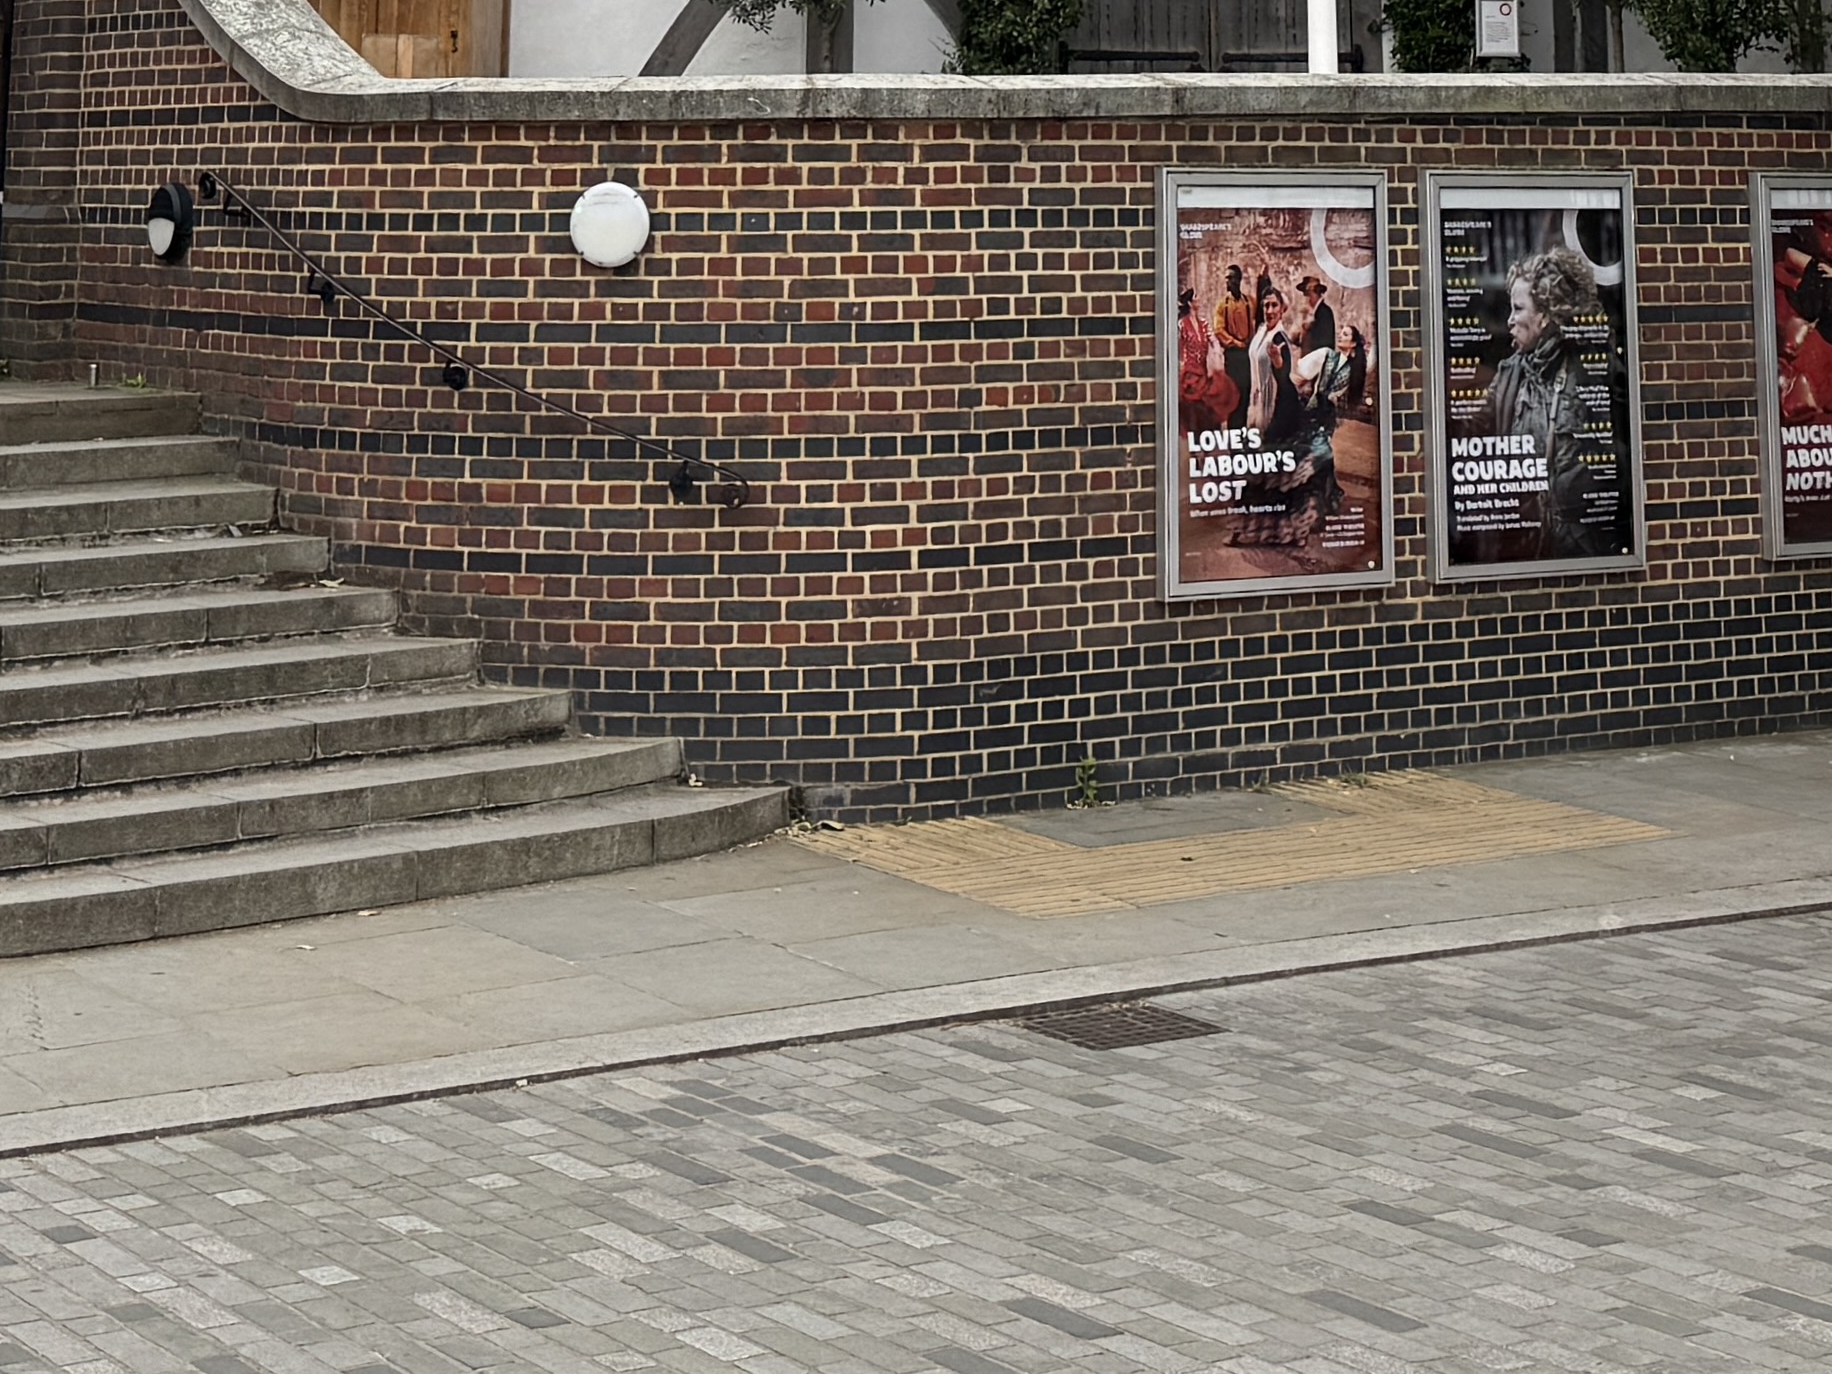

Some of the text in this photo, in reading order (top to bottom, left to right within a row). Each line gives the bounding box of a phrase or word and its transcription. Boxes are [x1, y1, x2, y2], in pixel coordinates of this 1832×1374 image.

[1187, 427, 1262, 452] LOVE'S
[1452, 434, 1536, 457] MOTHER
[1189, 450, 1297, 478] LABOUR'S
[1452, 458, 1548, 482] COURAGE
[1189, 480, 1247, 504] LOST
[1453, 480, 1549, 495] AND HER CHILDREN
